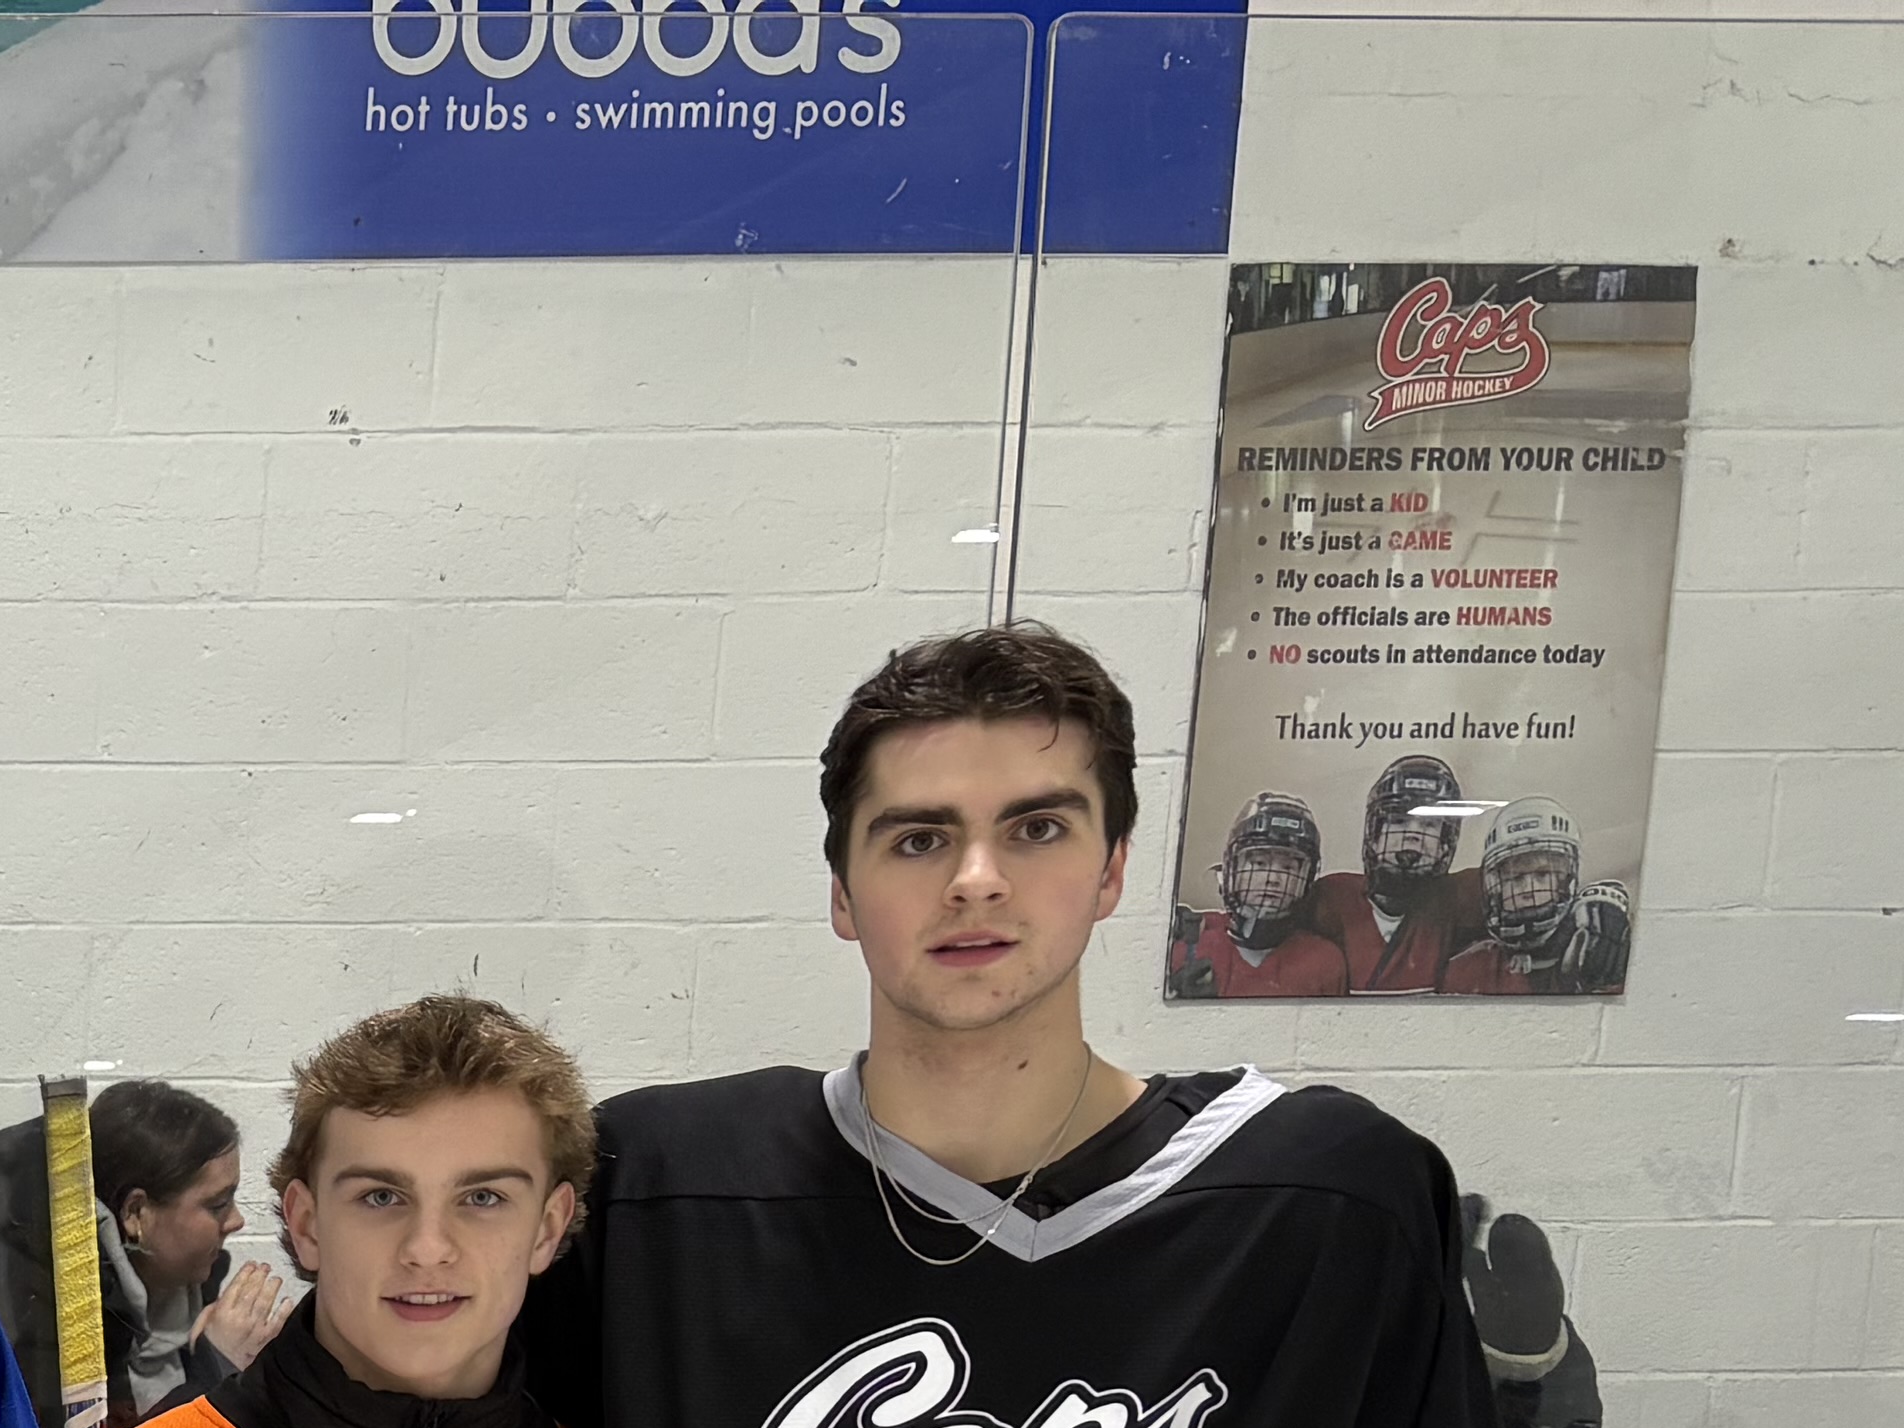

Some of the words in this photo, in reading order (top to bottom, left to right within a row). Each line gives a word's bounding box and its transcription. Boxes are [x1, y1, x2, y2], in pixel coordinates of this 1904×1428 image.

[365, 87, 429, 131] hot
[445, 87, 528, 131] tubs
[575, 89, 776, 140] swimming
[793, 83, 906, 140] pools
[1377, 277, 1549, 378] Caps
[1392, 381, 1446, 410] MINOR
[1451, 376, 1514, 400] HOCKEY
[1237, 446, 1402, 472] REMINDERS
[1410, 446, 1490, 472] FROM
[1500, 446, 1573, 472] YOUR
[1582, 446, 1666, 472] CHILD
[1283, 493, 1316, 512] I'm
[1321, 493, 1365, 516] just
[1370, 497, 1384, 512] a
[1390, 493, 1428, 512] KID
[1279, 531, 1314, 550] It's
[1318, 531, 1362, 554] just
[1368, 535, 1381, 550] a
[1388, 531, 1452, 550] GAME
[1276, 569, 1307, 592] My
[1314, 569, 1379, 589] coach
[1385, 569, 1404, 589] is
[1410, 573, 1424, 589] a
[1430, 568, 1558, 589] VOLUNTEER
[1272, 607, 1310, 626] The
[1317, 606, 1408, 627] officials
[1414, 611, 1450, 627] are
[1456, 607, 1552, 626] HUMANS
[1269, 645, 1301, 664] NO
[1307, 646, 1380, 664] scouts
[1386, 645, 1406, 664] in
[1412, 645, 1536, 664] attendance
[1542, 645, 1605, 668] today
[1275, 714, 1353, 740] Thank
[1355, 720, 1402, 749] you
[1409, 713, 1455, 740] and
[1461, 713, 1519, 740] have
[1526, 713, 1575, 740] fun!
